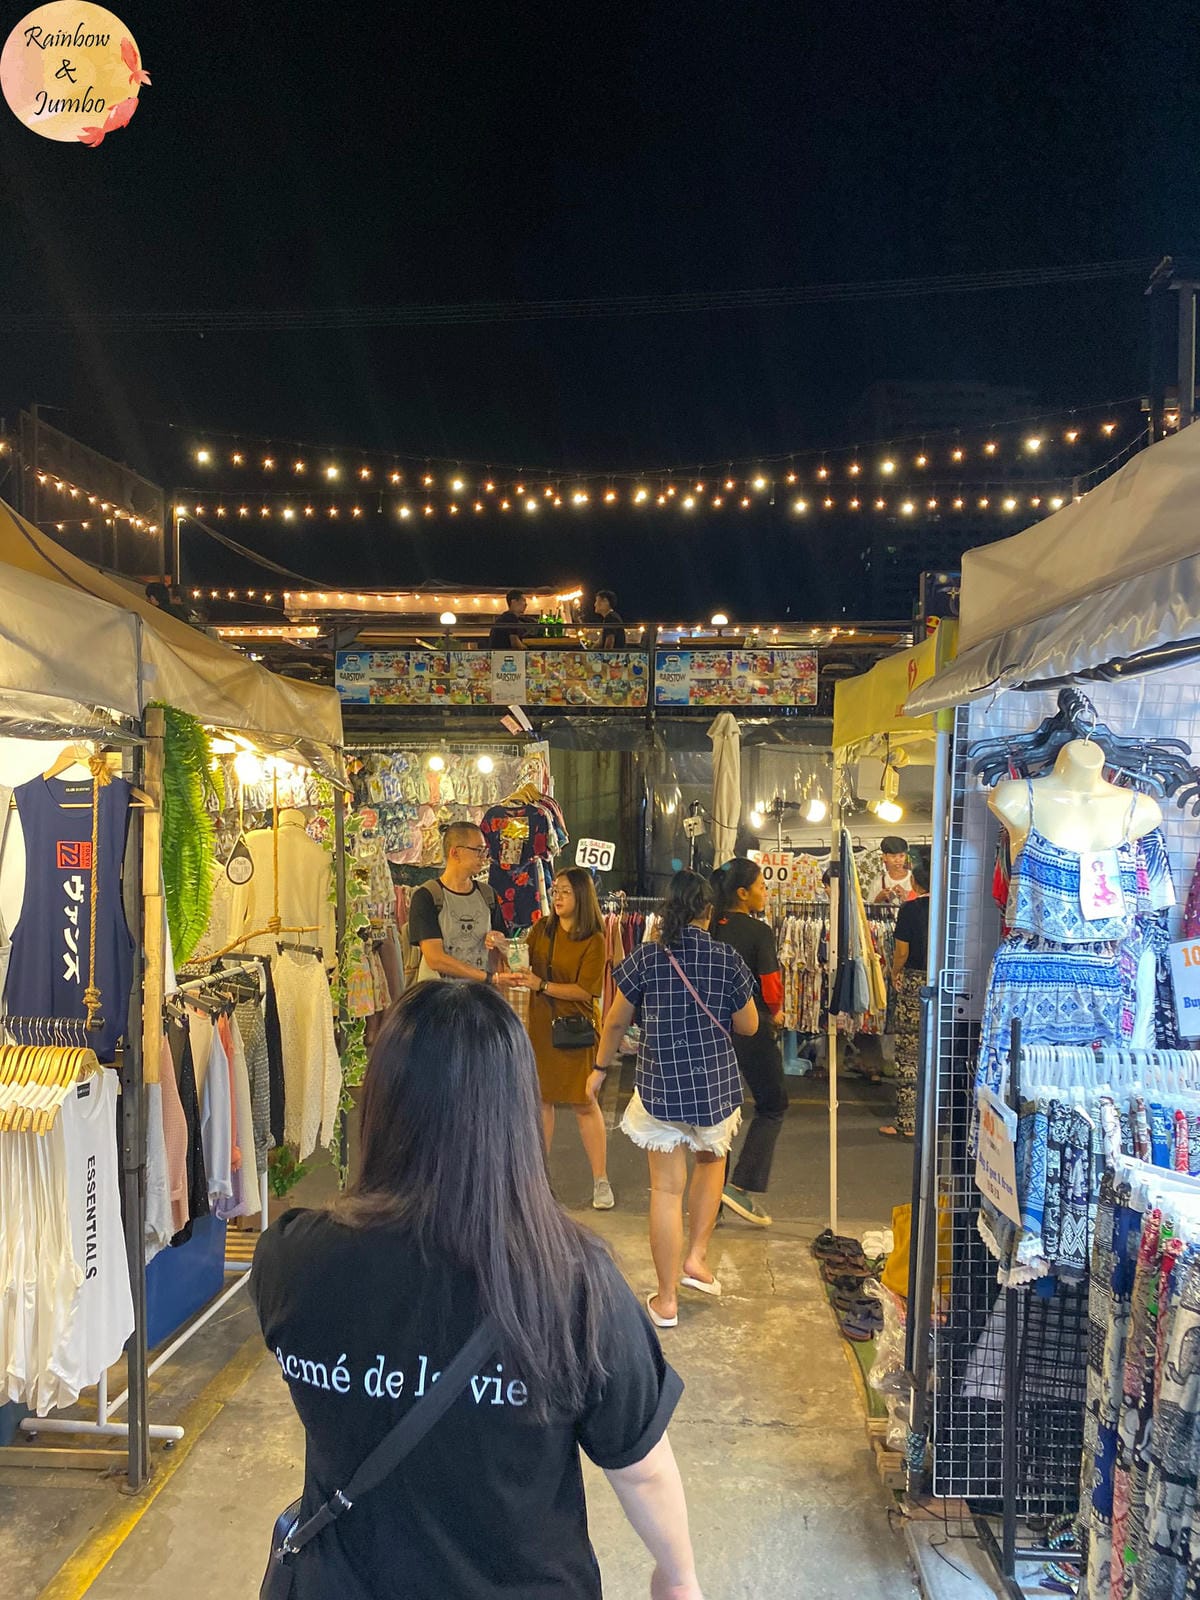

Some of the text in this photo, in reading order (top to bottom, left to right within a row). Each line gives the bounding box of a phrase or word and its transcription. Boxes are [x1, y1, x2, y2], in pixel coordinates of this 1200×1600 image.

[61, 843, 79, 865] 72
[580, 847, 611, 866] 150
[754, 853, 789, 866] SALE
[763, 866, 788, 881] 00
[63, 875, 85, 985] ヴァンス
[86, 1155, 97, 1280] ESSENTIALS
[364, 1354, 404, 1399] de
[414, 1355, 441, 1397] l
[470, 1363, 528, 1406] vie
